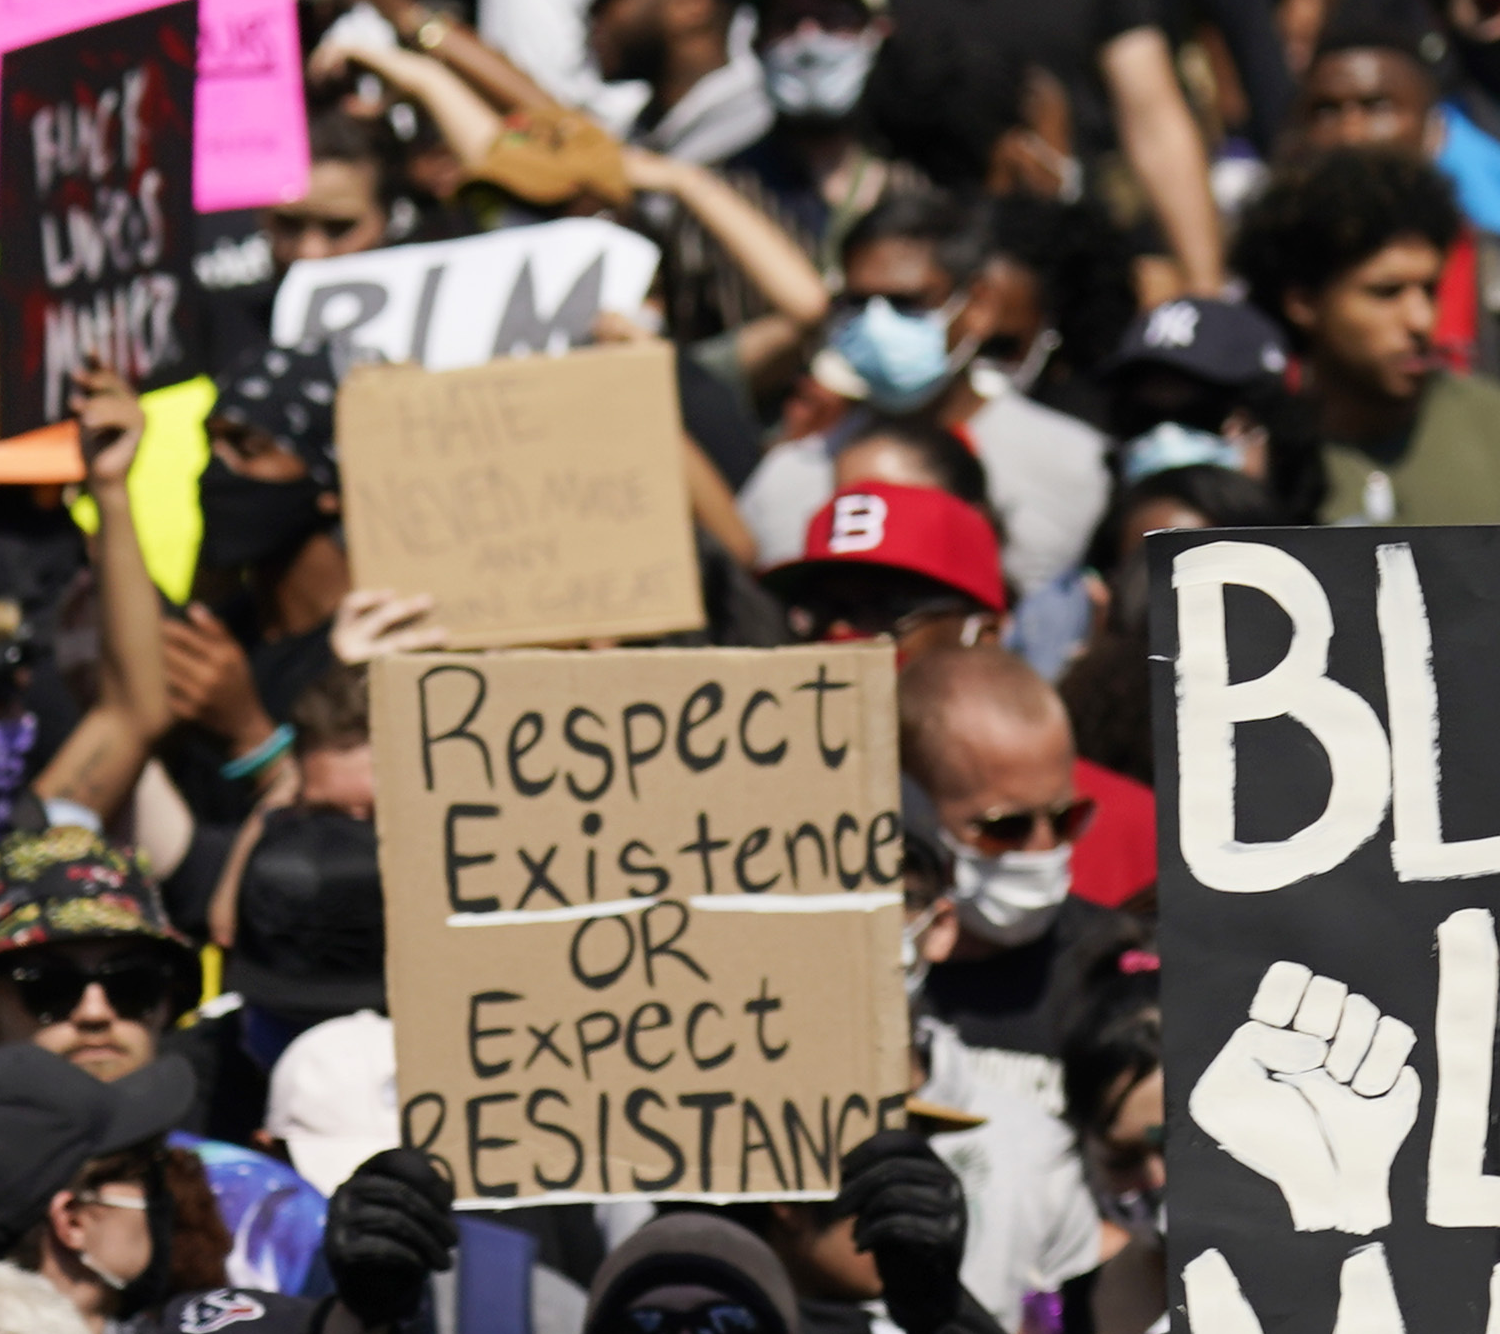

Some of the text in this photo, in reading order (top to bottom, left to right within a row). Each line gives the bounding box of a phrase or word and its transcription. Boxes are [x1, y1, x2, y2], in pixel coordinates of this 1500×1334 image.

[397, 374, 549, 459] HATE
[828, 493, 888, 555] B
[417, 664, 852, 801] Respect
[443, 804, 903, 914] Existence
[569, 900, 710, 989] OR
[467, 977, 790, 1081] Expect
